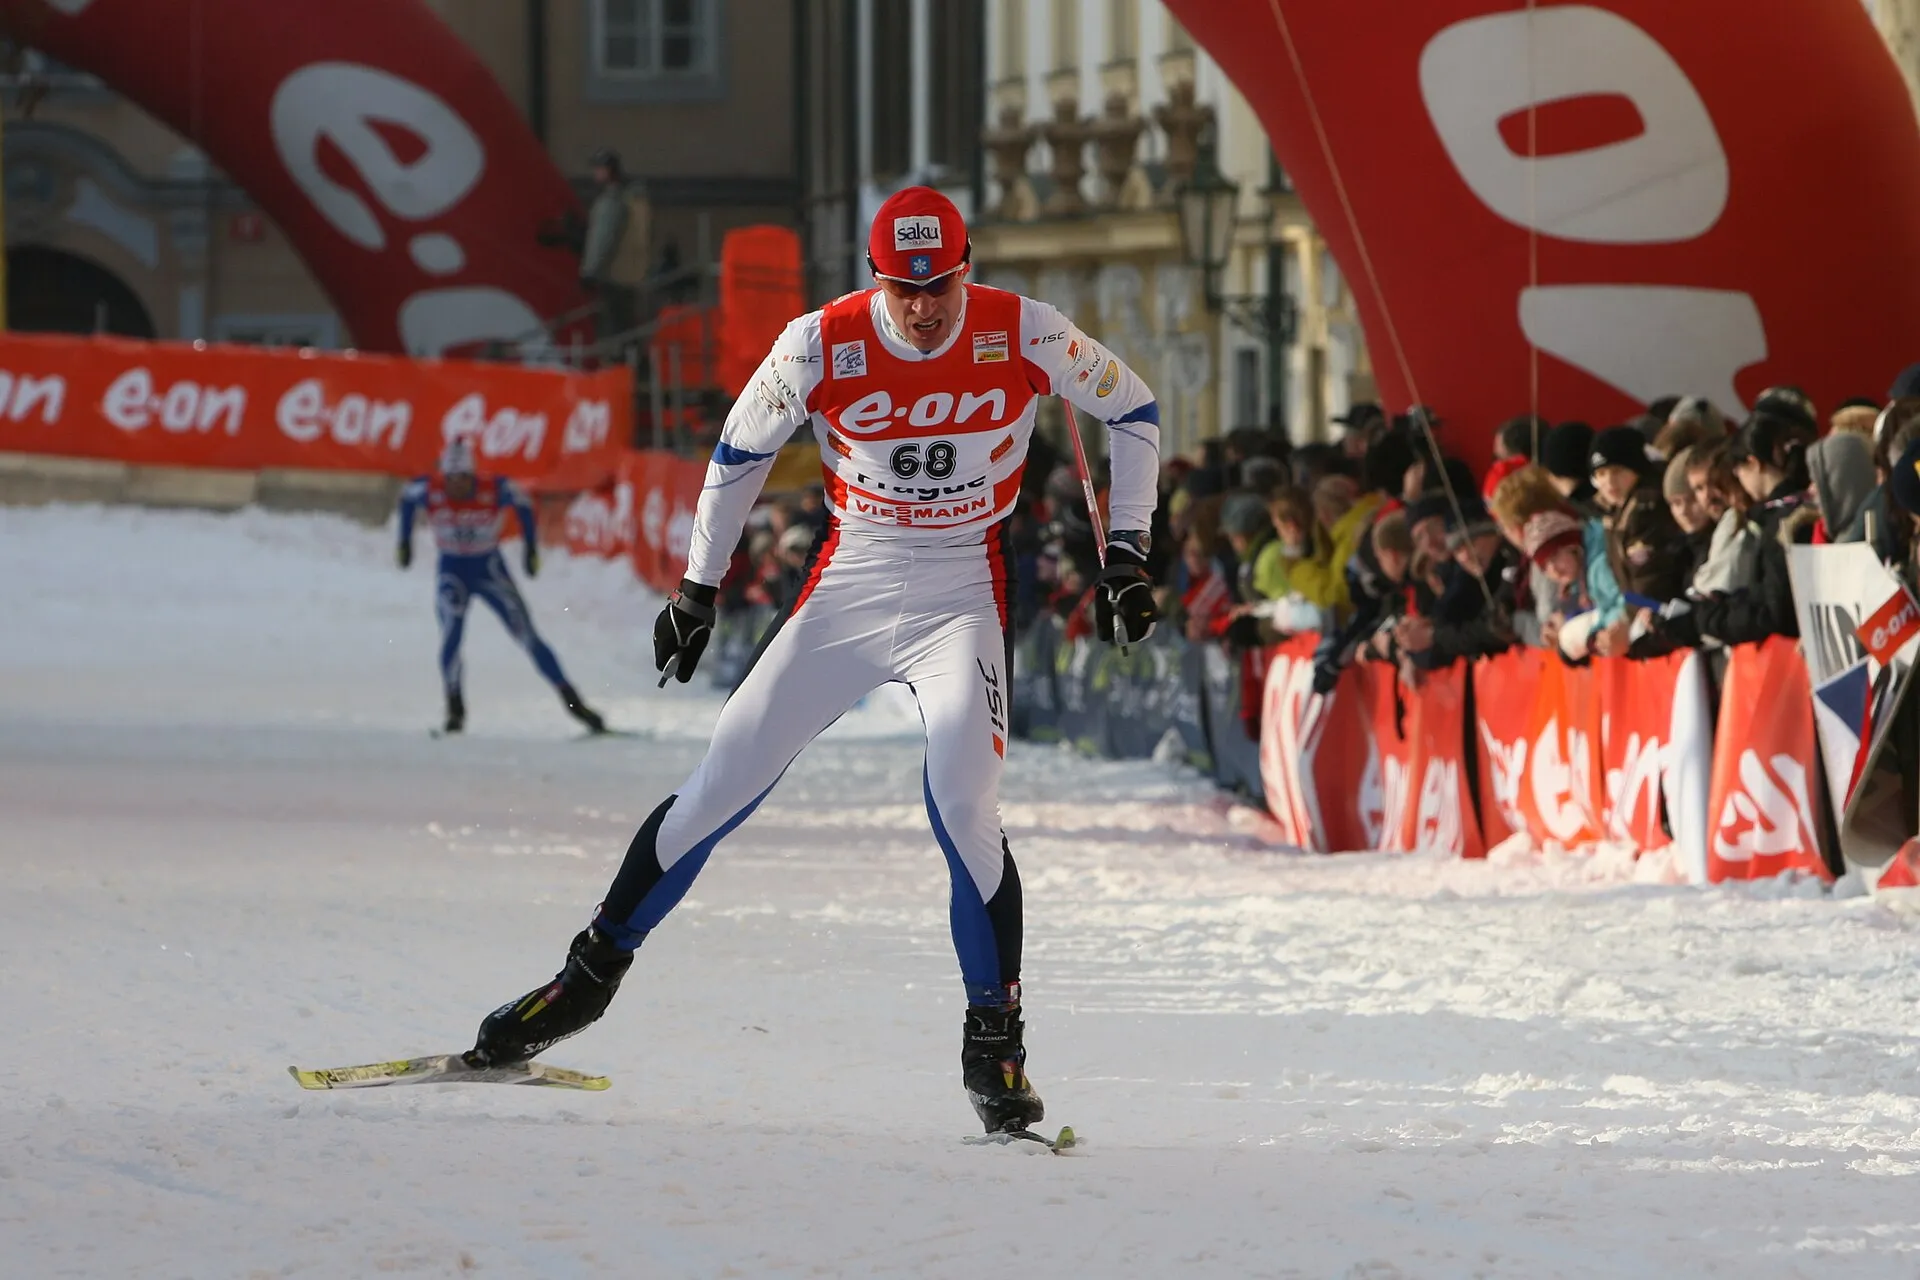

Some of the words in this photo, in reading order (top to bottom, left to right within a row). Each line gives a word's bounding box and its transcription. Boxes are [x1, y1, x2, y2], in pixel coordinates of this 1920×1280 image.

[897, 222, 939, 241] saku
[1042, 331, 1065, 344] ISC
[791, 355, 821, 363] ISC
[889, 440, 957, 480] 68
[855, 497, 986, 525] VIESSMANN
[977, 657, 1004, 732] ISC
